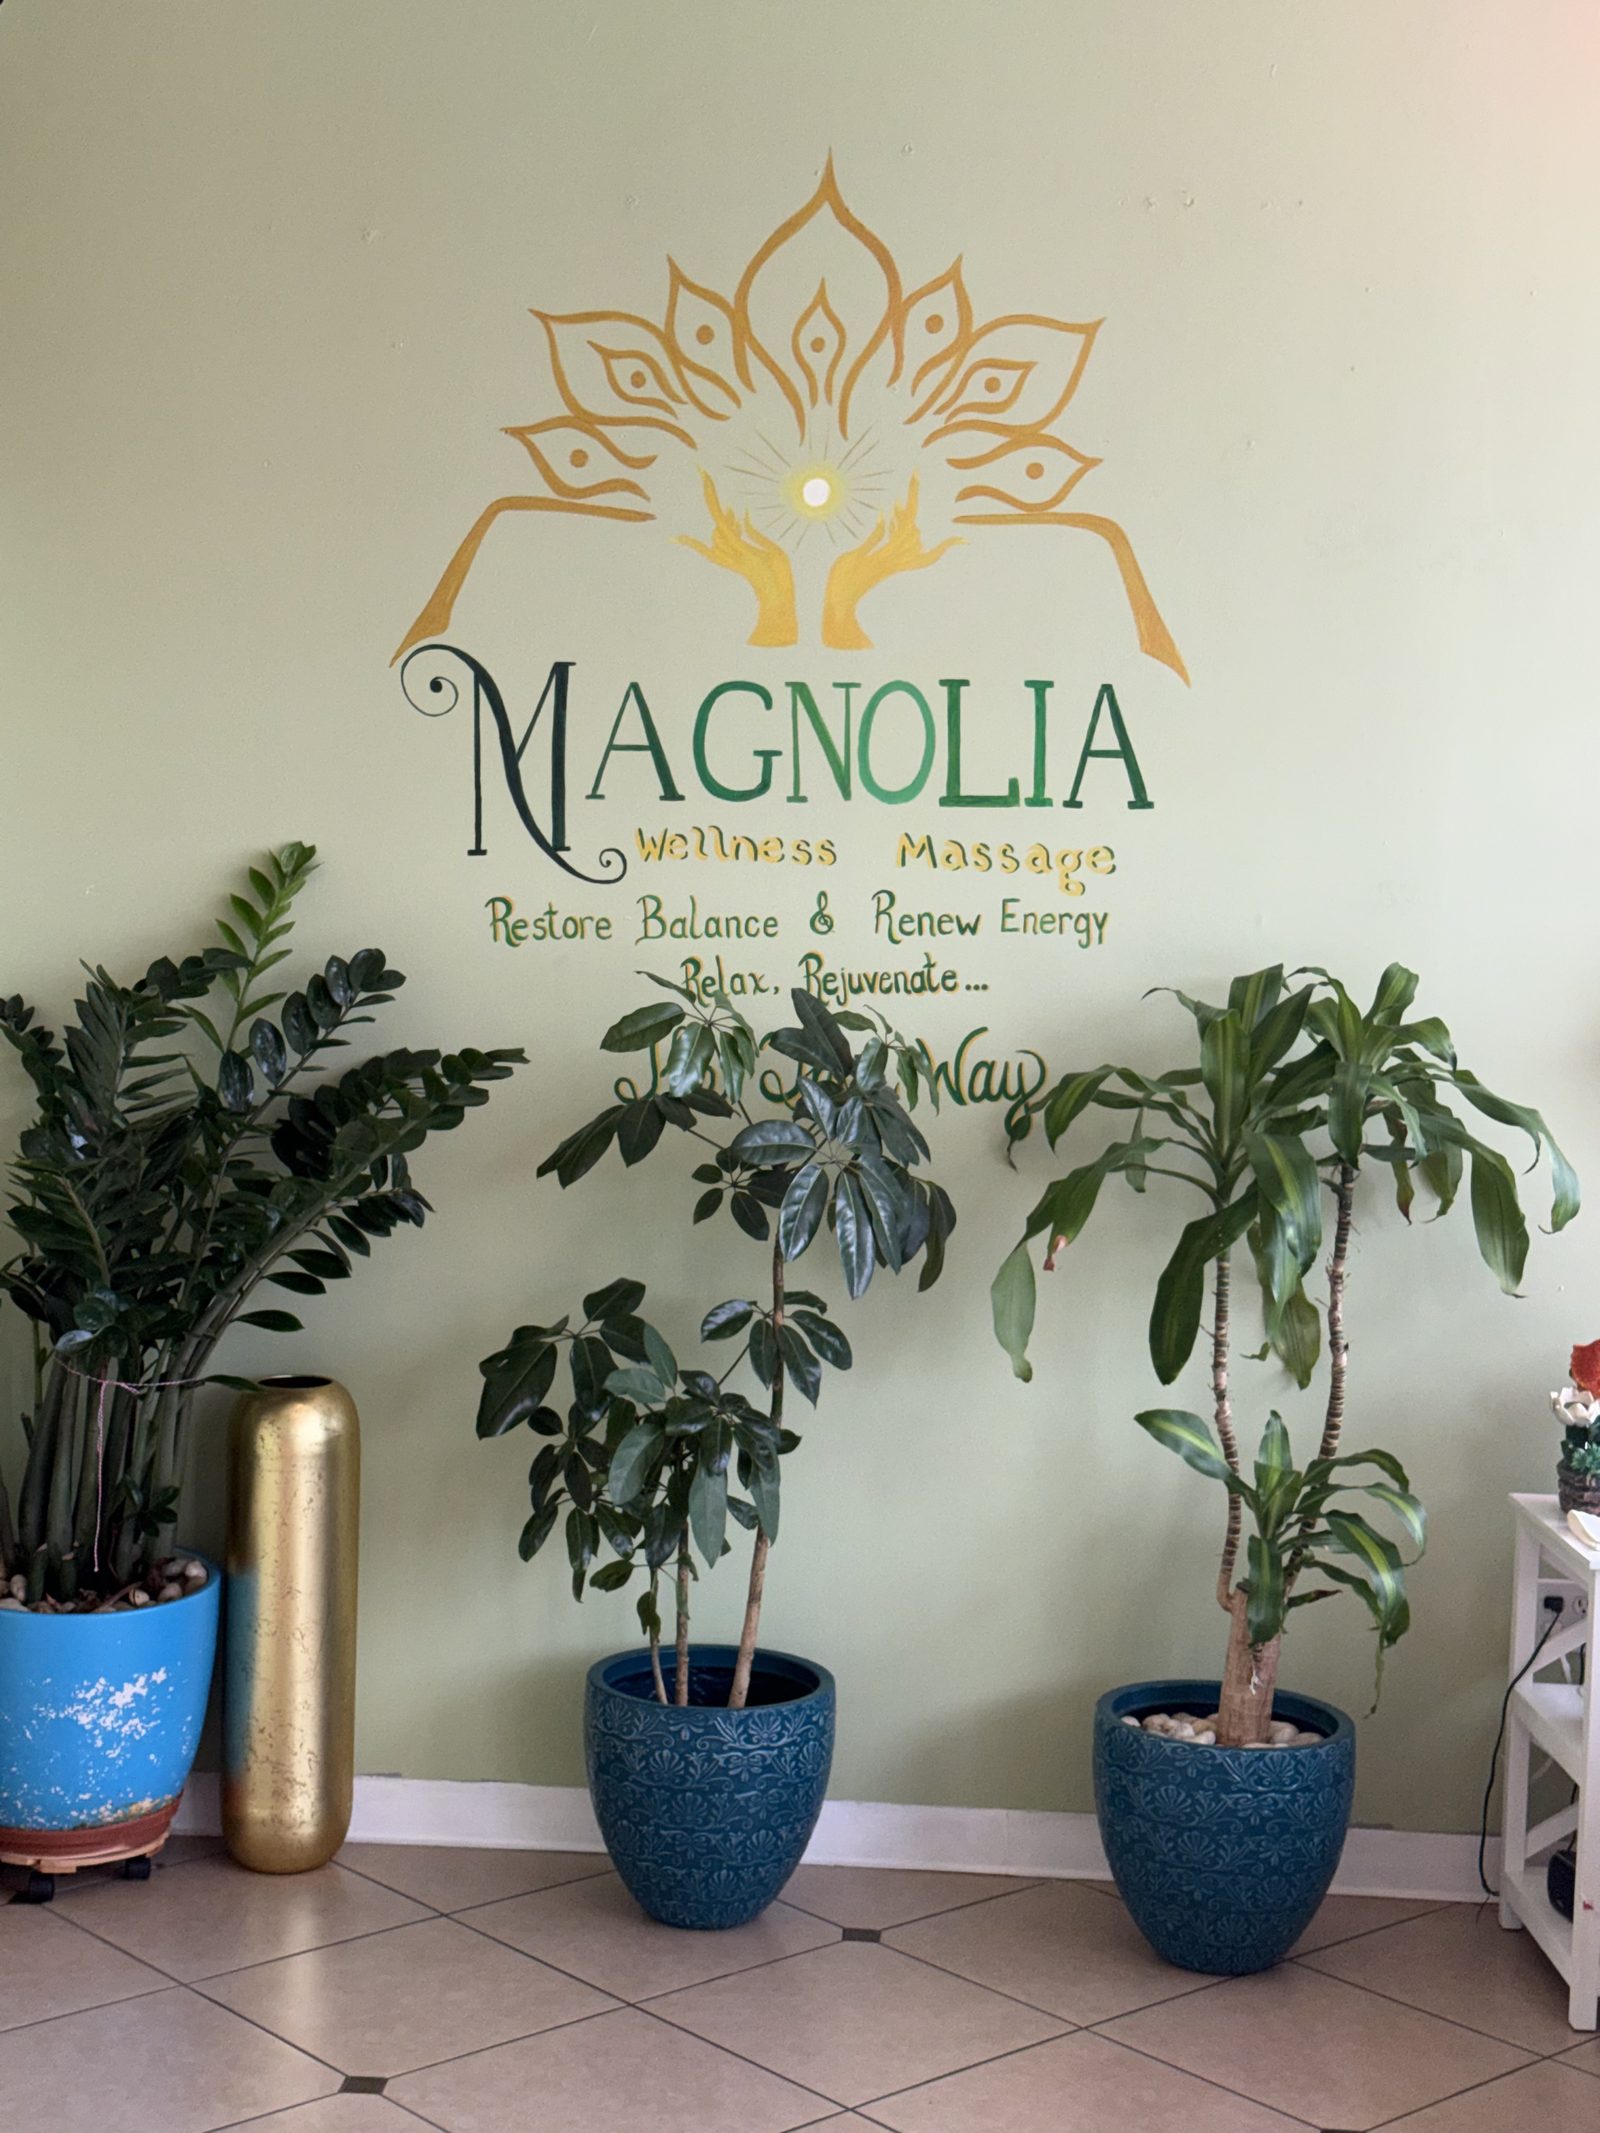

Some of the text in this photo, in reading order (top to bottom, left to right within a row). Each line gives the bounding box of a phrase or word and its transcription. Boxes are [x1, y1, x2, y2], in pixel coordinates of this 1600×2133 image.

[400, 644, 1155, 884] MAGNOLIA
[635, 825, 1116, 897] Wellness Massage
[486, 889, 1110, 949] Restore Balance & Renew Energy
[680, 954, 779, 1008] Relax,
[914, 1026, 1047, 1142] Way
